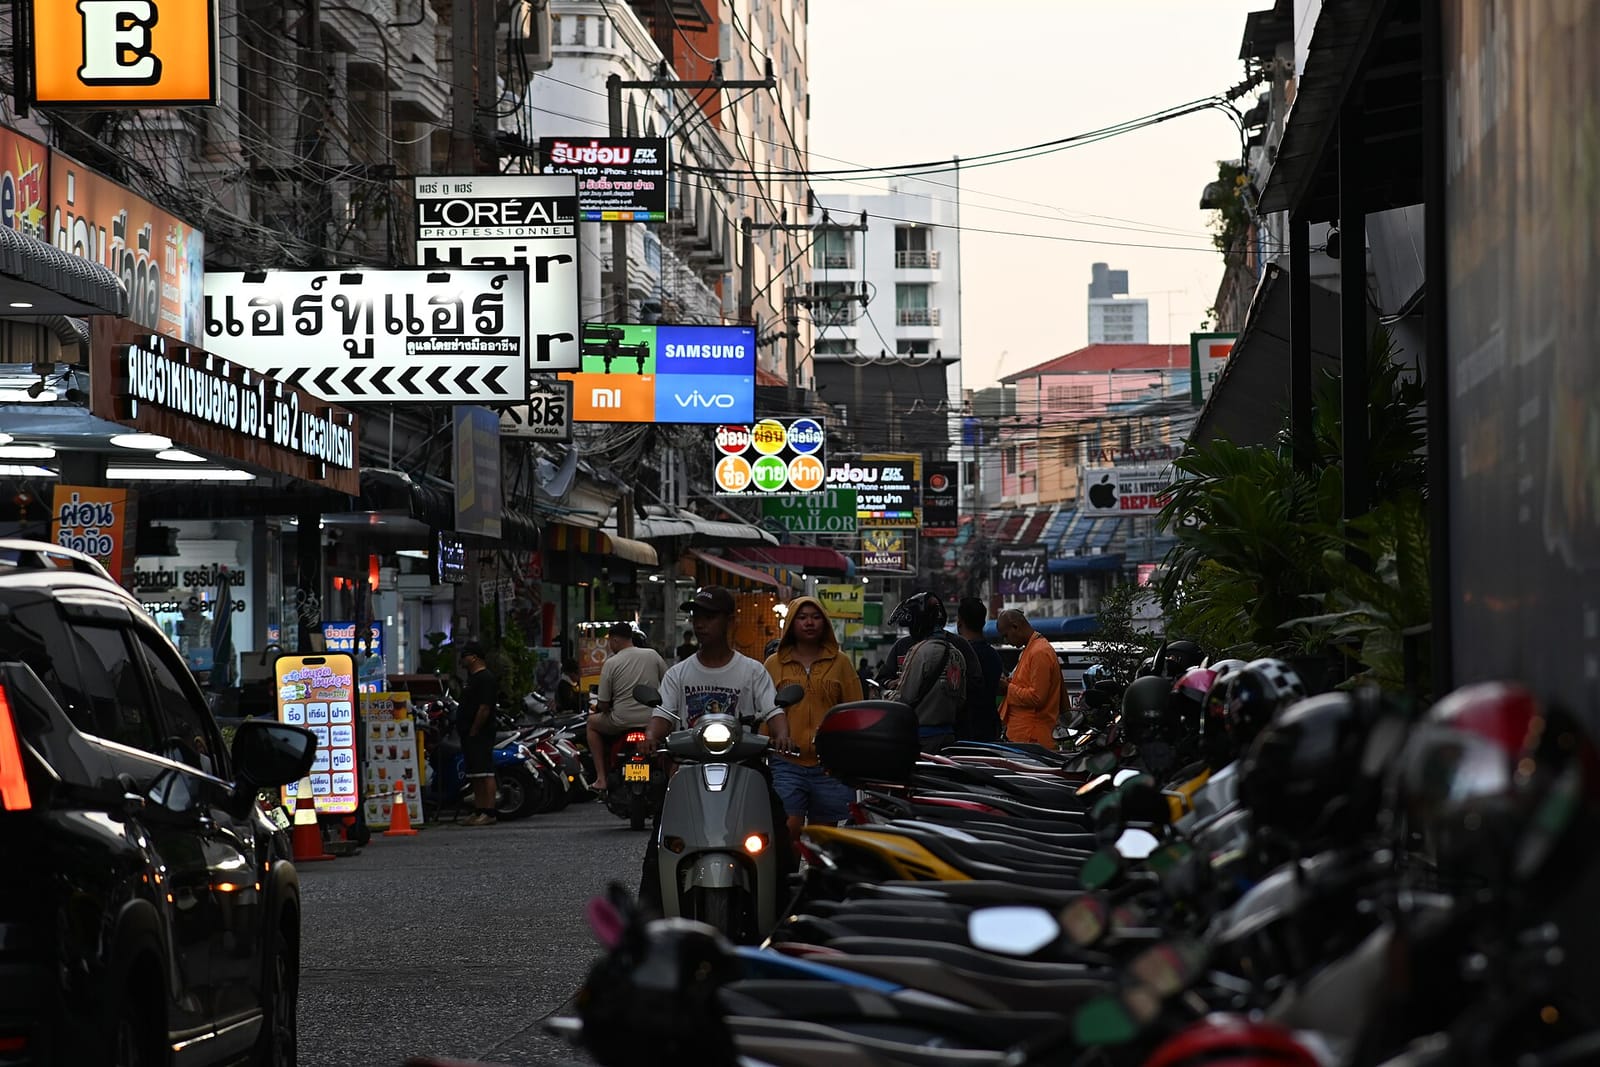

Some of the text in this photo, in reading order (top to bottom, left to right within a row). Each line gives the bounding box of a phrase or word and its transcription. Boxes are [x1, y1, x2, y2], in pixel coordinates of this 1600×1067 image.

[78, 0, 161, 85] E
[551, 140, 631, 164] รับซ่อม
[634, 148, 657, 158] FIX
[584, 167, 598, 175] LCD
[419, 199, 574, 226] L'ORÉAL
[424, 226, 572, 237] PROFESSIONNEL
[407, 338, 518, 355] ดูแลโดยช่างมืออาชีพ
[665, 344, 745, 359] SAMSUNG
[674, 390, 735, 407] vivo
[534, 427, 559, 435] OSAKA
[717, 427, 748, 446] ซ่อม
[754, 425, 783, 443] ผ่อน
[723, 458, 820, 486] ซื้อ ขาย ฝาก
[1120, 481, 1133, 493] MAC
[60, 492, 114, 527] ผ่อน
[780, 515, 855, 531] TAILOR
[59, 528, 113, 556] มือถือ
[864, 556, 902, 564] MASSAGE
[138, 595, 246, 615] epair Serce
[288, 707, 301, 720] ซื้อ
[332, 707, 349, 718] ฝาก
